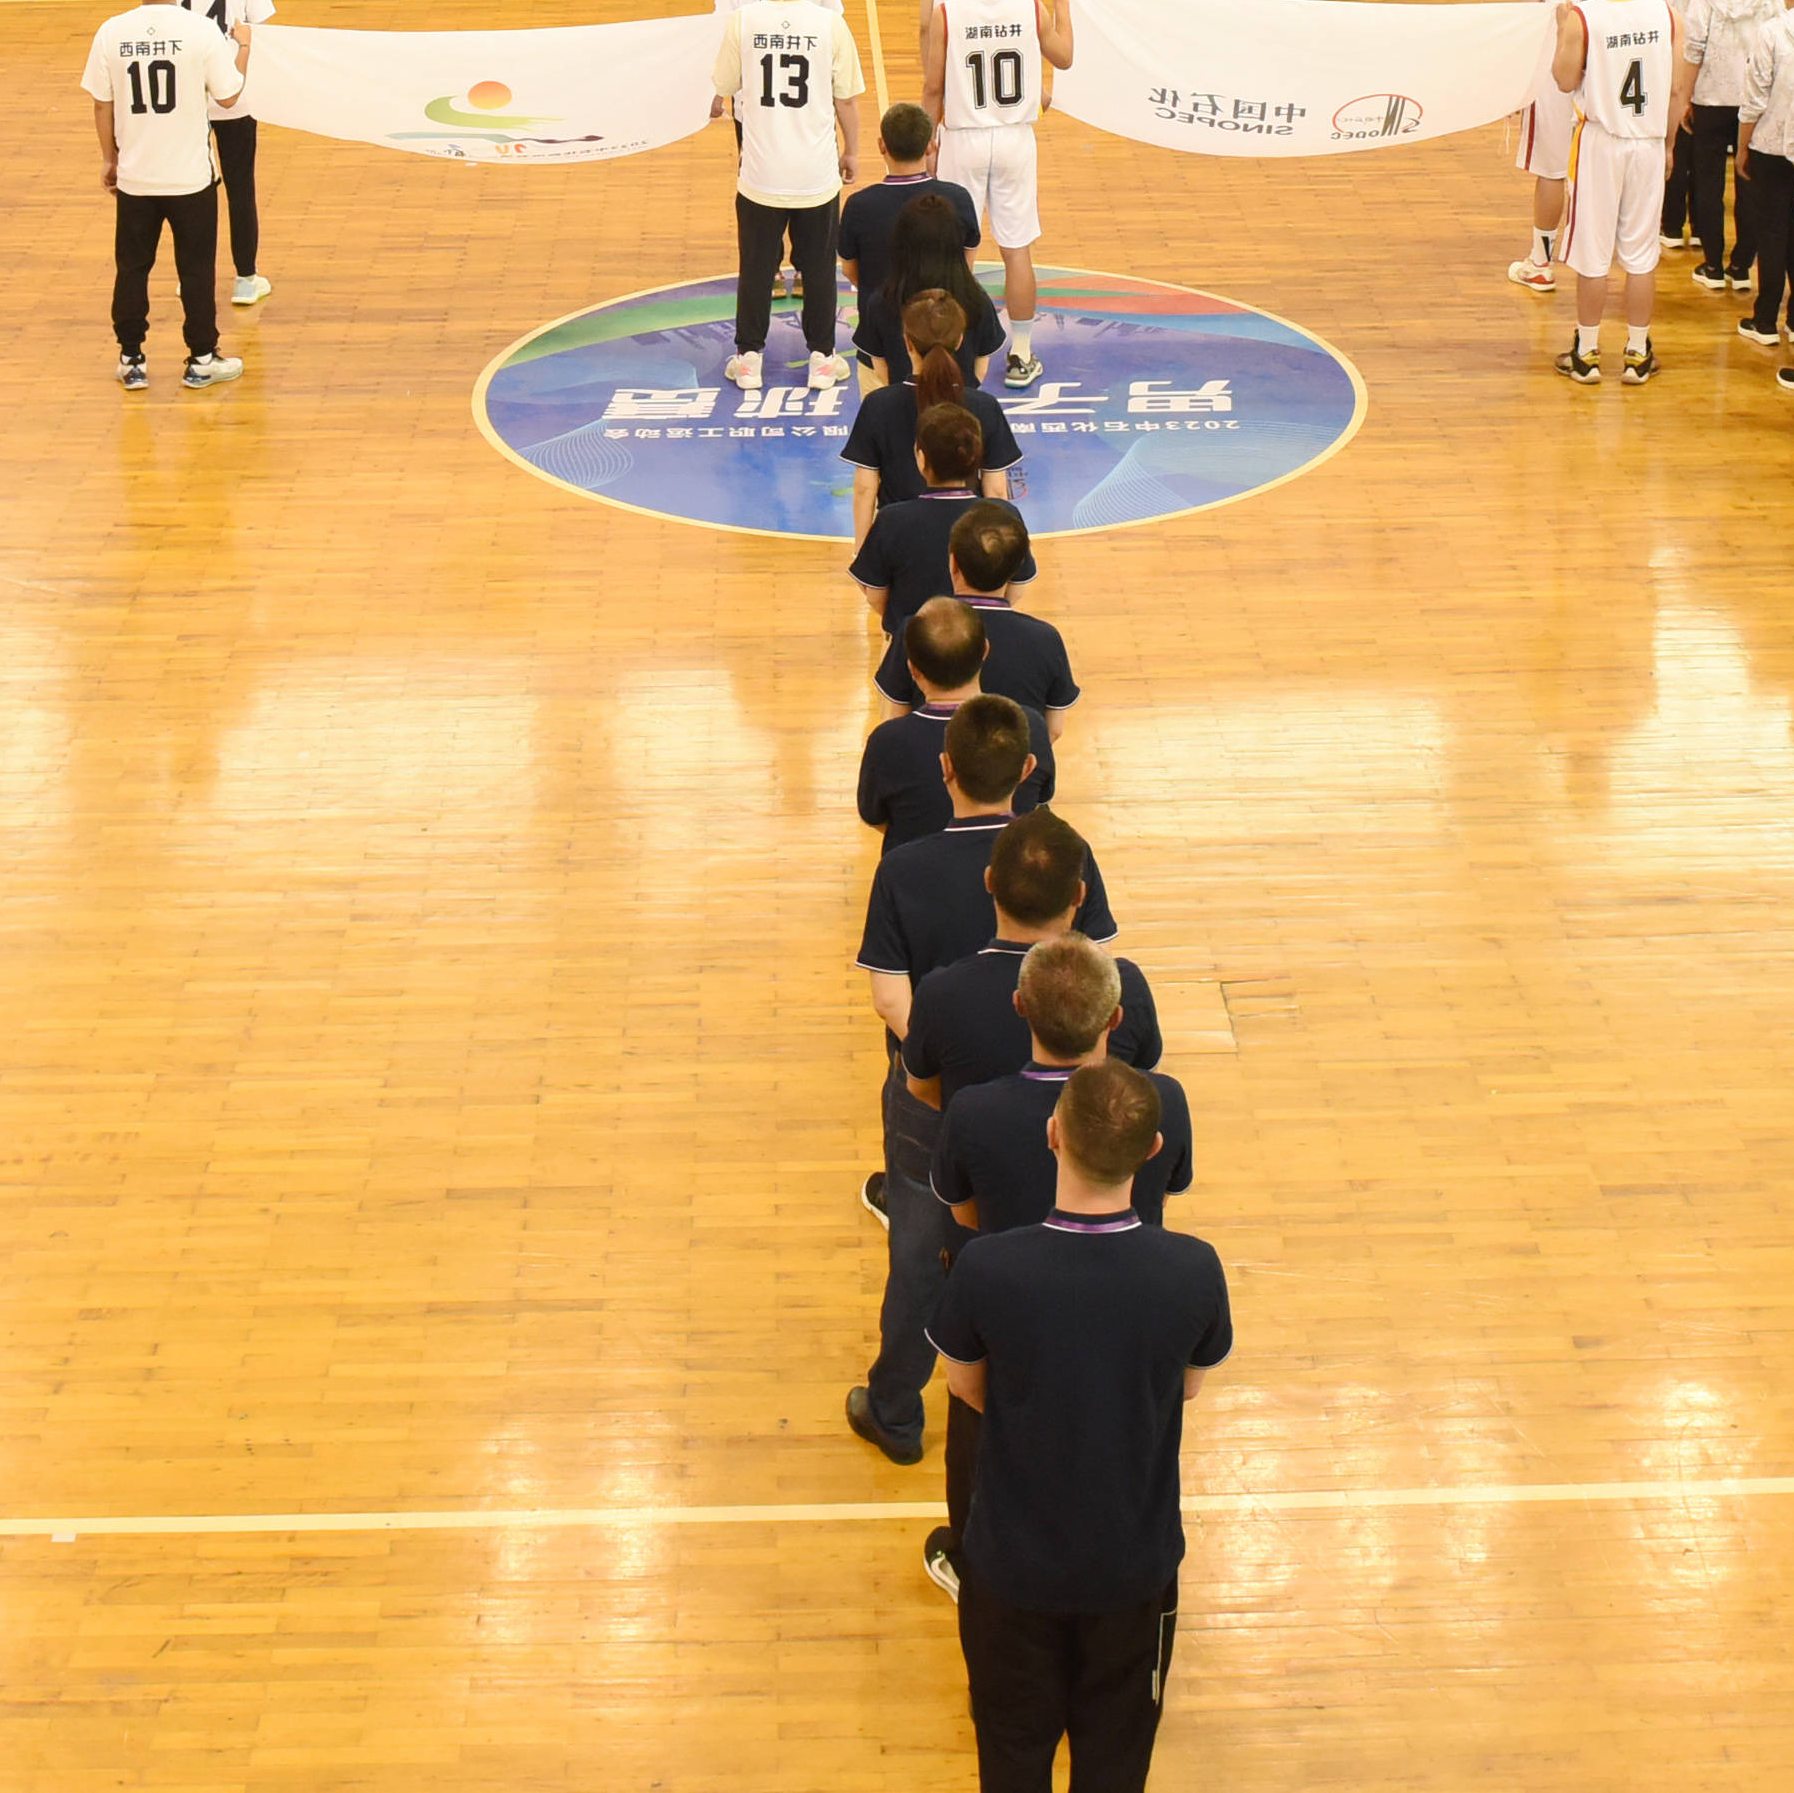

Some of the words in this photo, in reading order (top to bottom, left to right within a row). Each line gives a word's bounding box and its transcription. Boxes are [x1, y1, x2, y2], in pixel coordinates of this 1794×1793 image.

[119, 40, 183, 57] 西南井下
[753, 34, 818, 51] 西南井下
[965, 24, 1022, 40] 湖南钻井
[1606, 30, 1660, 49] 湖南钻井
[127, 60, 176, 114] 10
[760, 54, 809, 108] 13
[965, 47, 1025, 110] 10
[1619, 57, 1648, 117] 4
